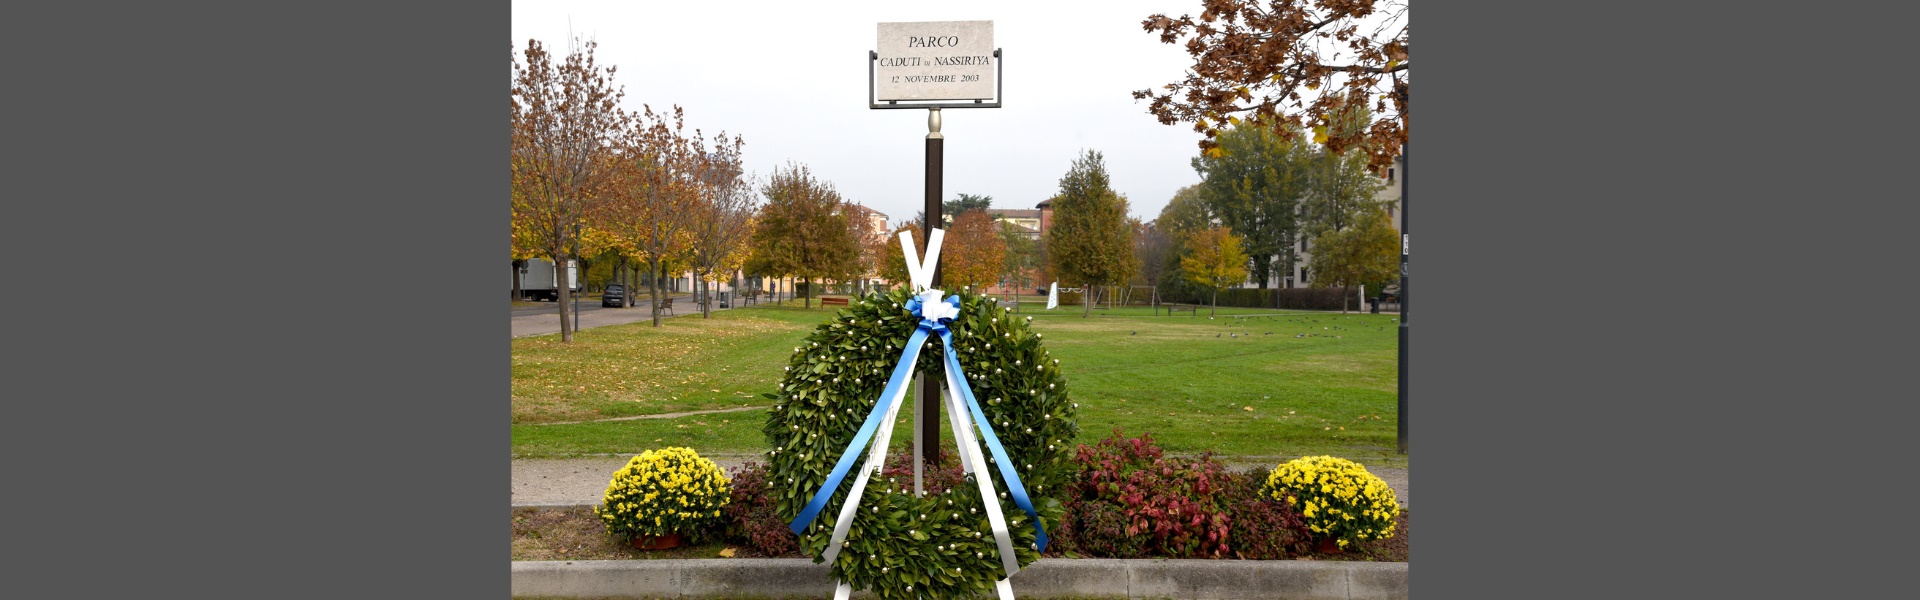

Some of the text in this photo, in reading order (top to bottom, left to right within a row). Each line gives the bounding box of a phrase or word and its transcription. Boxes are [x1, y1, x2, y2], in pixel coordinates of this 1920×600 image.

[908, 35, 959, 48] PARCO
[880, 57, 920, 66] CADUTI
[934, 56, 990, 66] NASSIRIYA
[891, 74, 980, 84] 12 NOVEMBRE 2003
